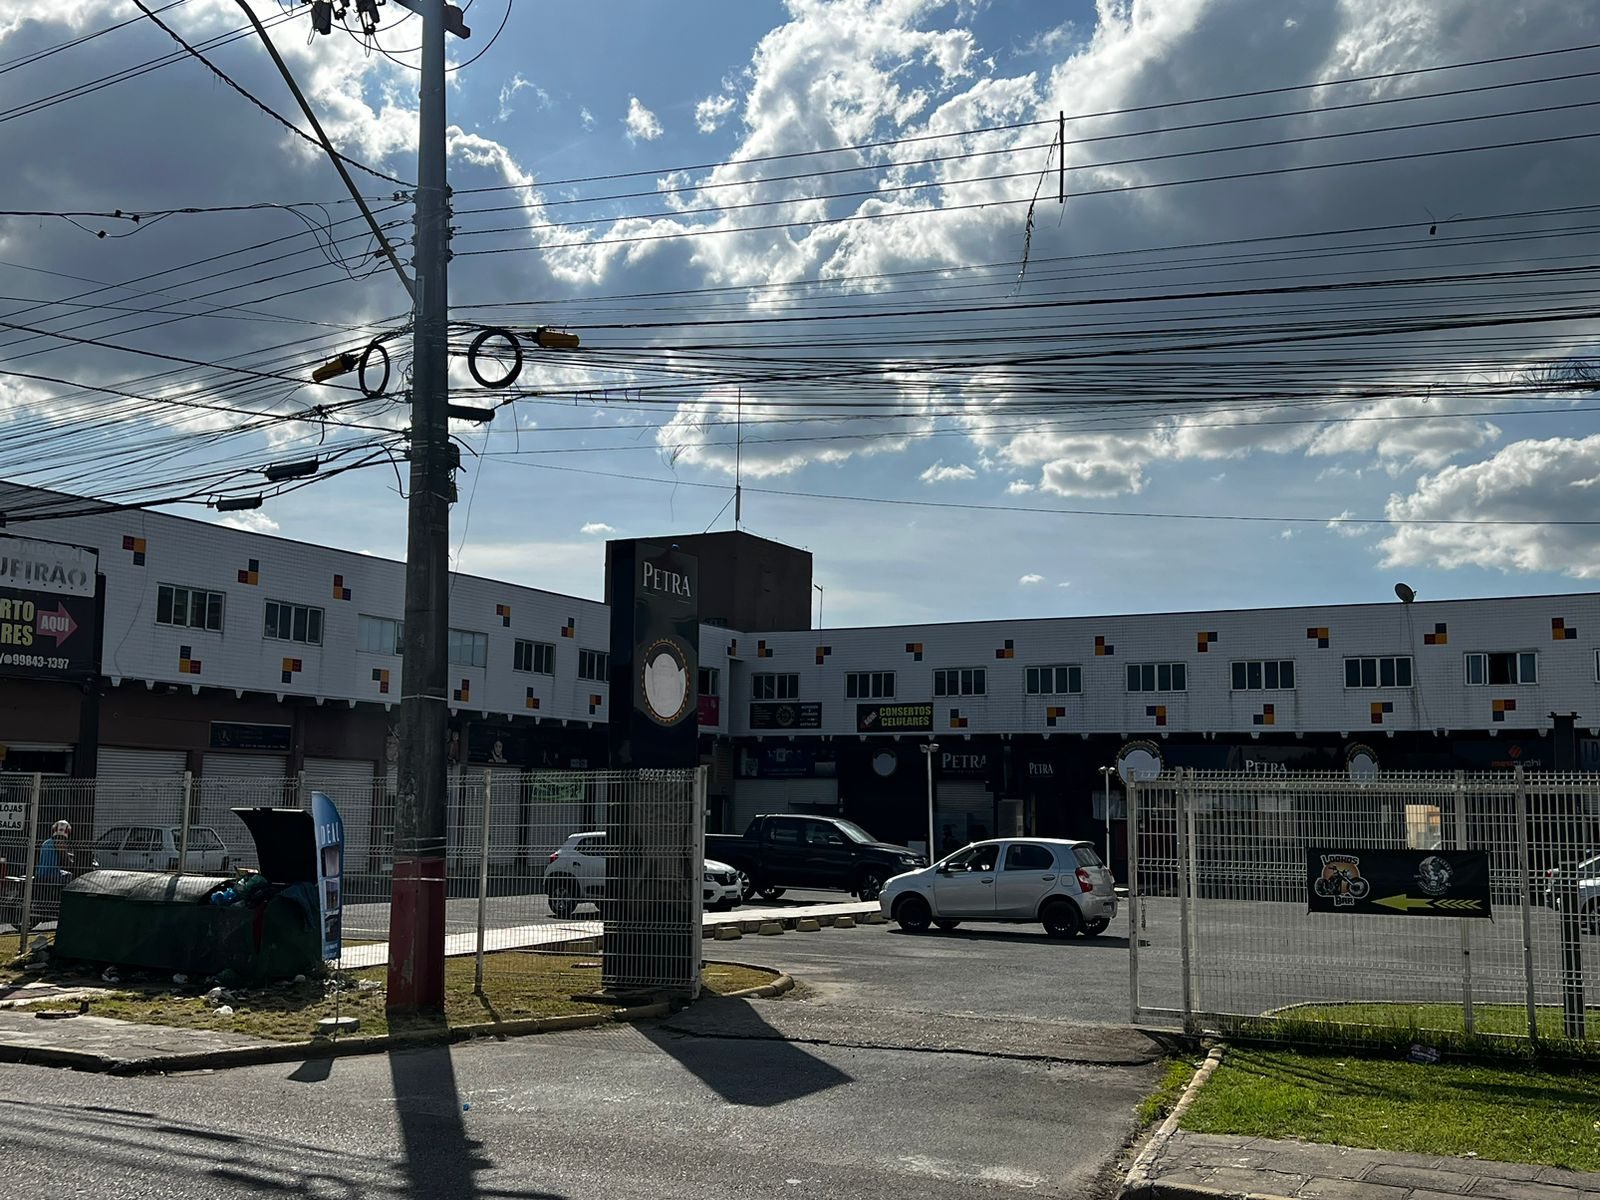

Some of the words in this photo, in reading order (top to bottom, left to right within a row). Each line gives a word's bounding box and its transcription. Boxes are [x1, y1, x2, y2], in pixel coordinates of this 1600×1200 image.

[642, 561, 691, 597] PETRA
[41, 615, 70, 632] AQUI
[0, 623, 33, 647] RES
[879, 706, 932, 717] CONSERTOS
[881, 716, 930, 727] CELULARES
[941, 752, 987, 768] PETRA
[1028, 761, 1054, 775] PETRA
[0, 804, 23, 813] LOJAS
